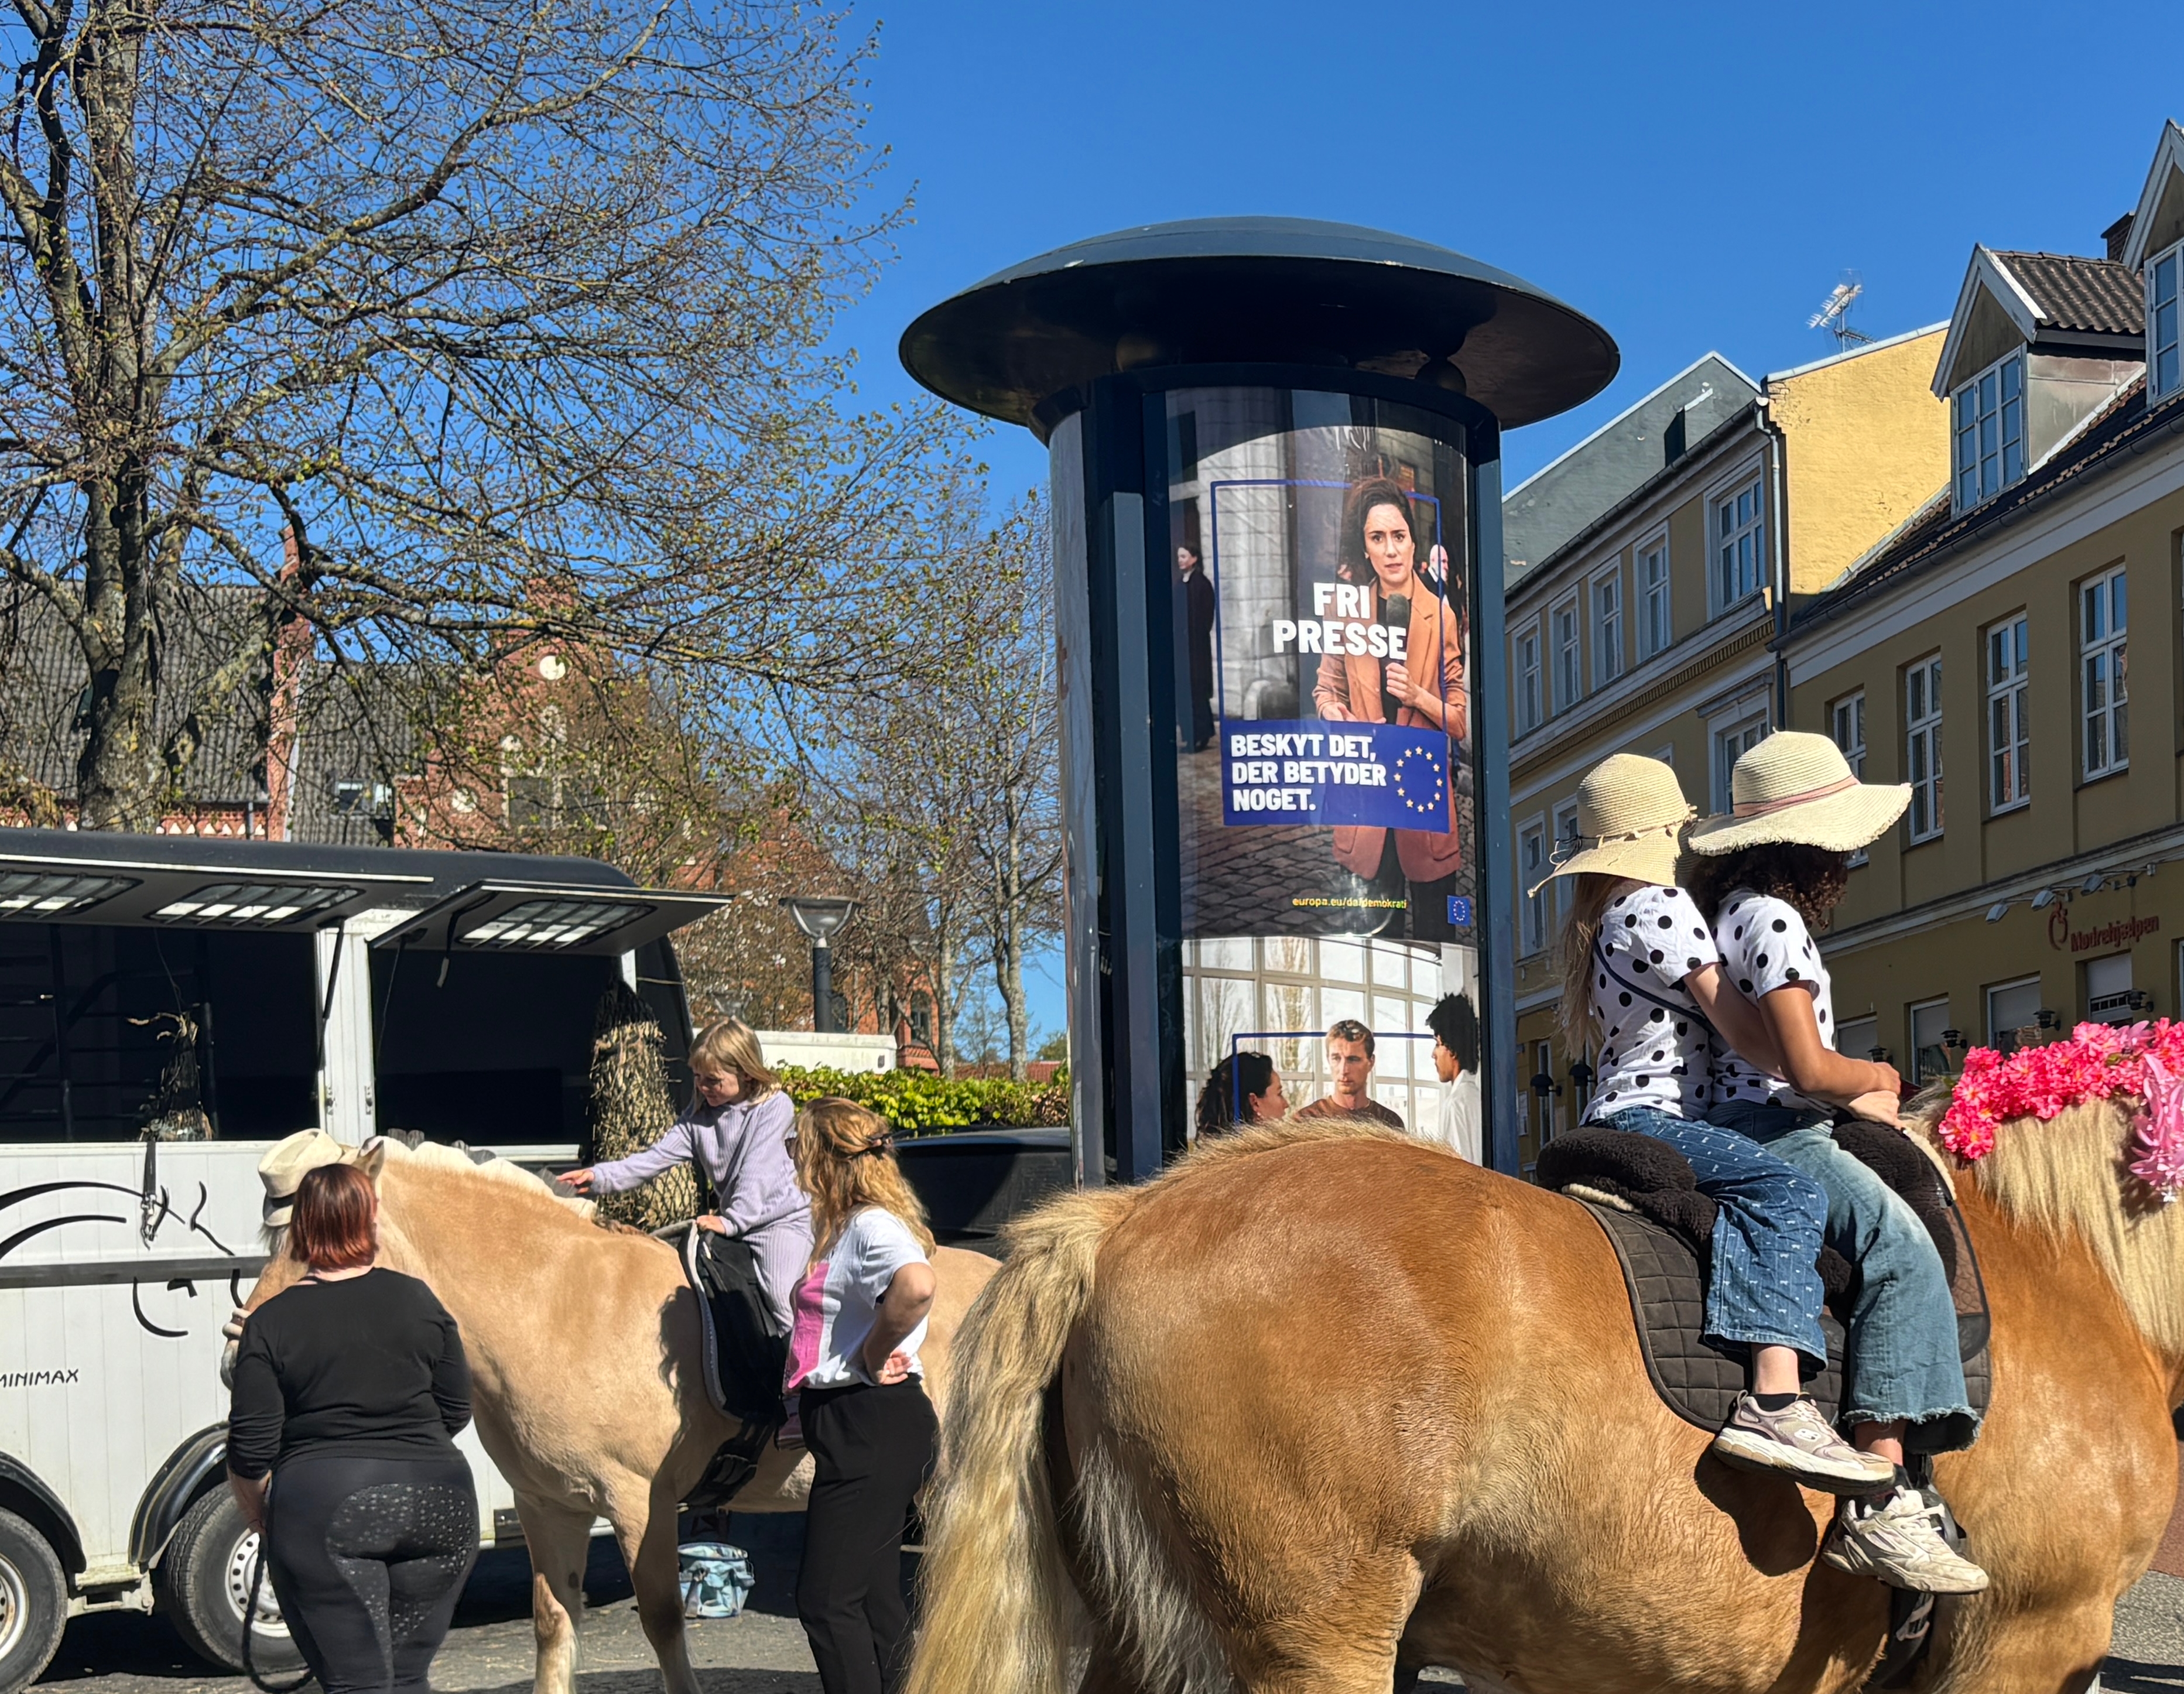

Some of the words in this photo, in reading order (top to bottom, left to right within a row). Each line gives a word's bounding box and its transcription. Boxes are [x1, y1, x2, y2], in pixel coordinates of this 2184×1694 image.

[1313, 583, 1370, 619] FRI
[1273, 620, 1407, 661] PRESSE
[1231, 734, 1324, 758] BESKYT
[1329, 735, 1377, 762] DET,
[1232, 762, 1278, 784] DER
[1284, 762, 1387, 786] BETYDER
[1233, 789, 1316, 812] NOGET.
